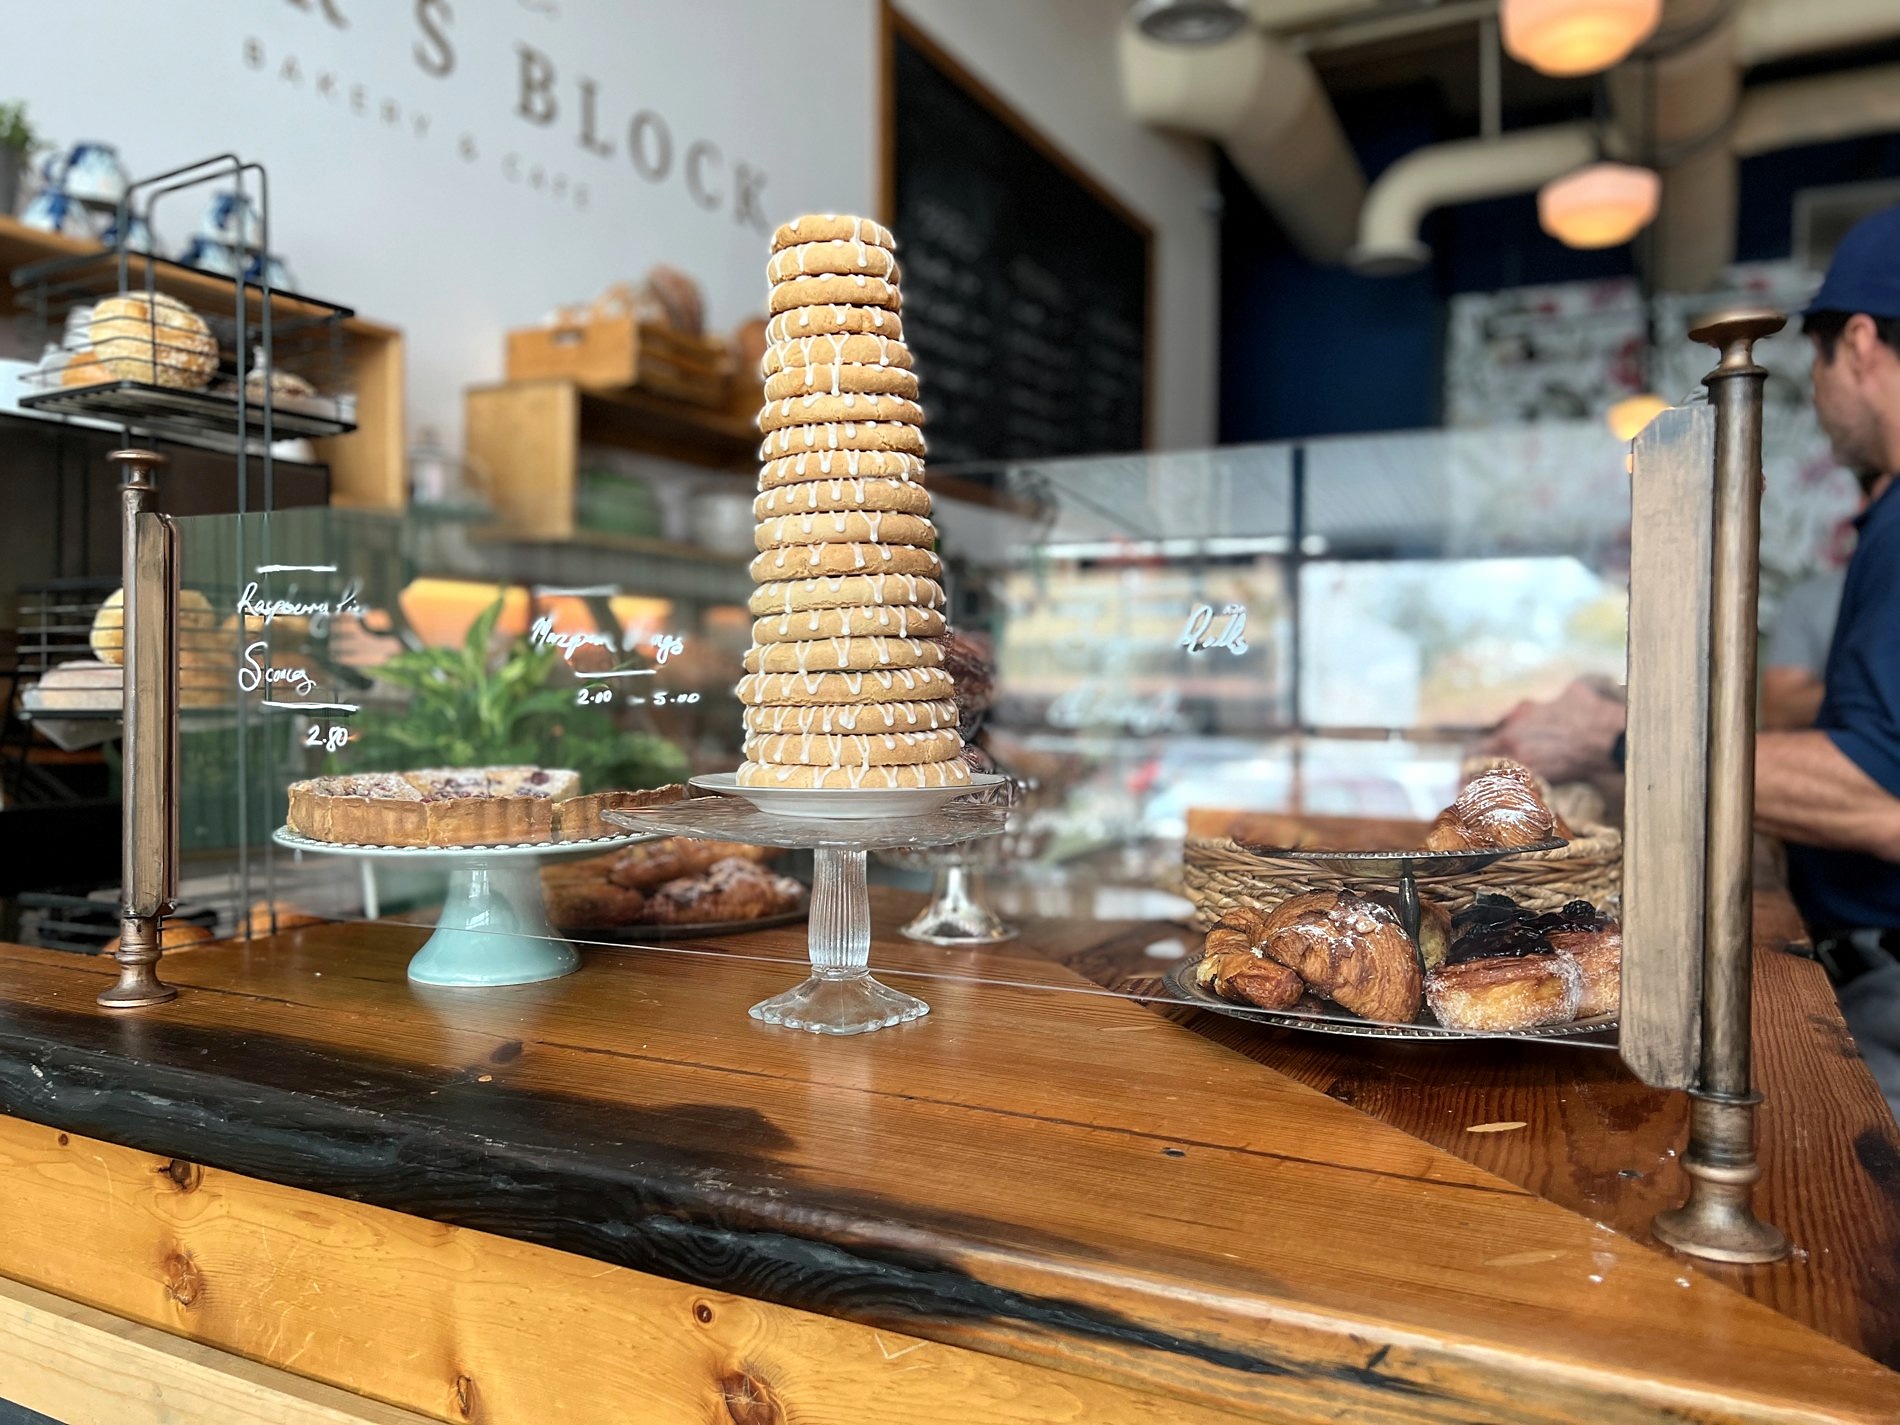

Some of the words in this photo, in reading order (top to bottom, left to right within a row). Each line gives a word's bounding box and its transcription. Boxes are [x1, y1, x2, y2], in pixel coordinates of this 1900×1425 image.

[243, 36, 431, 138] BAKERY
[512, 40, 770, 236] BLOCK
[304, 725, 349, 753] 2.80
